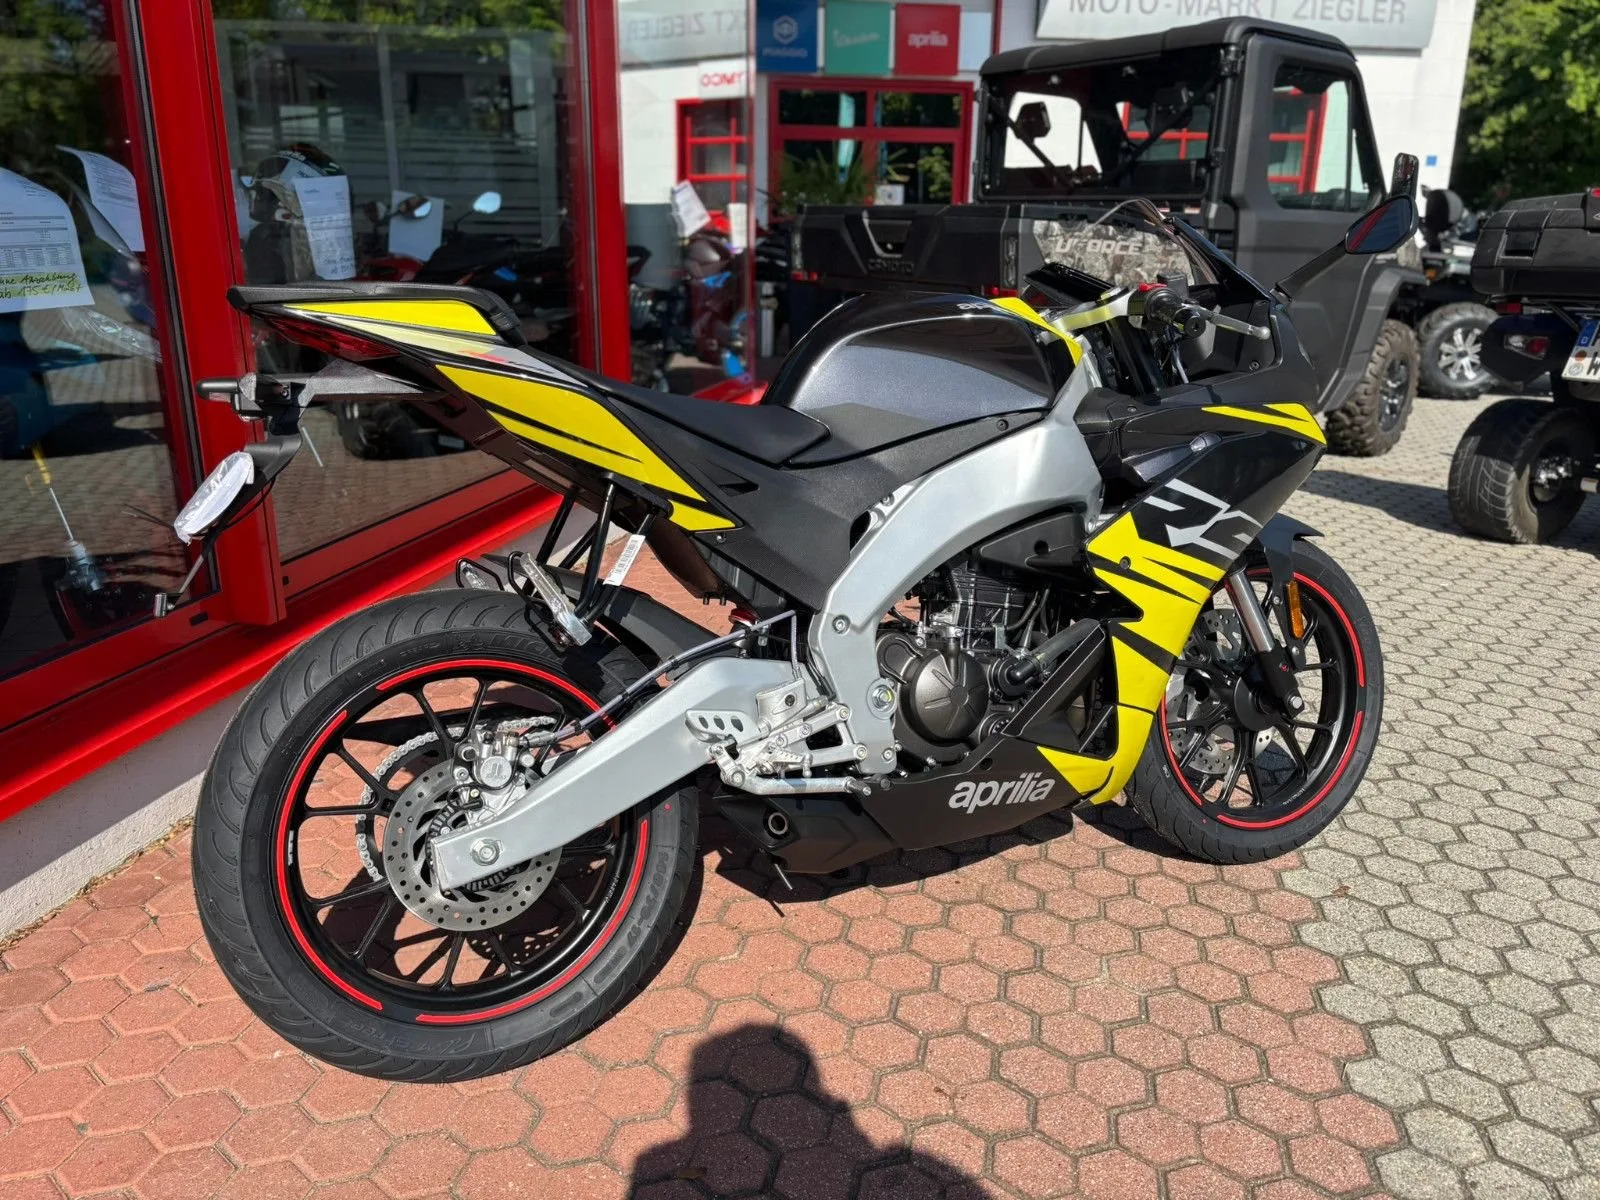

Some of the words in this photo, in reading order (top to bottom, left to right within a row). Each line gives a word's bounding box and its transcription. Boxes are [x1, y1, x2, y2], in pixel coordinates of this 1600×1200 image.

[1292, 0, 1406, 25] ZIEGLER
[907, 31, 949, 48] aprilia
[948, 772, 1056, 814] aprilia
